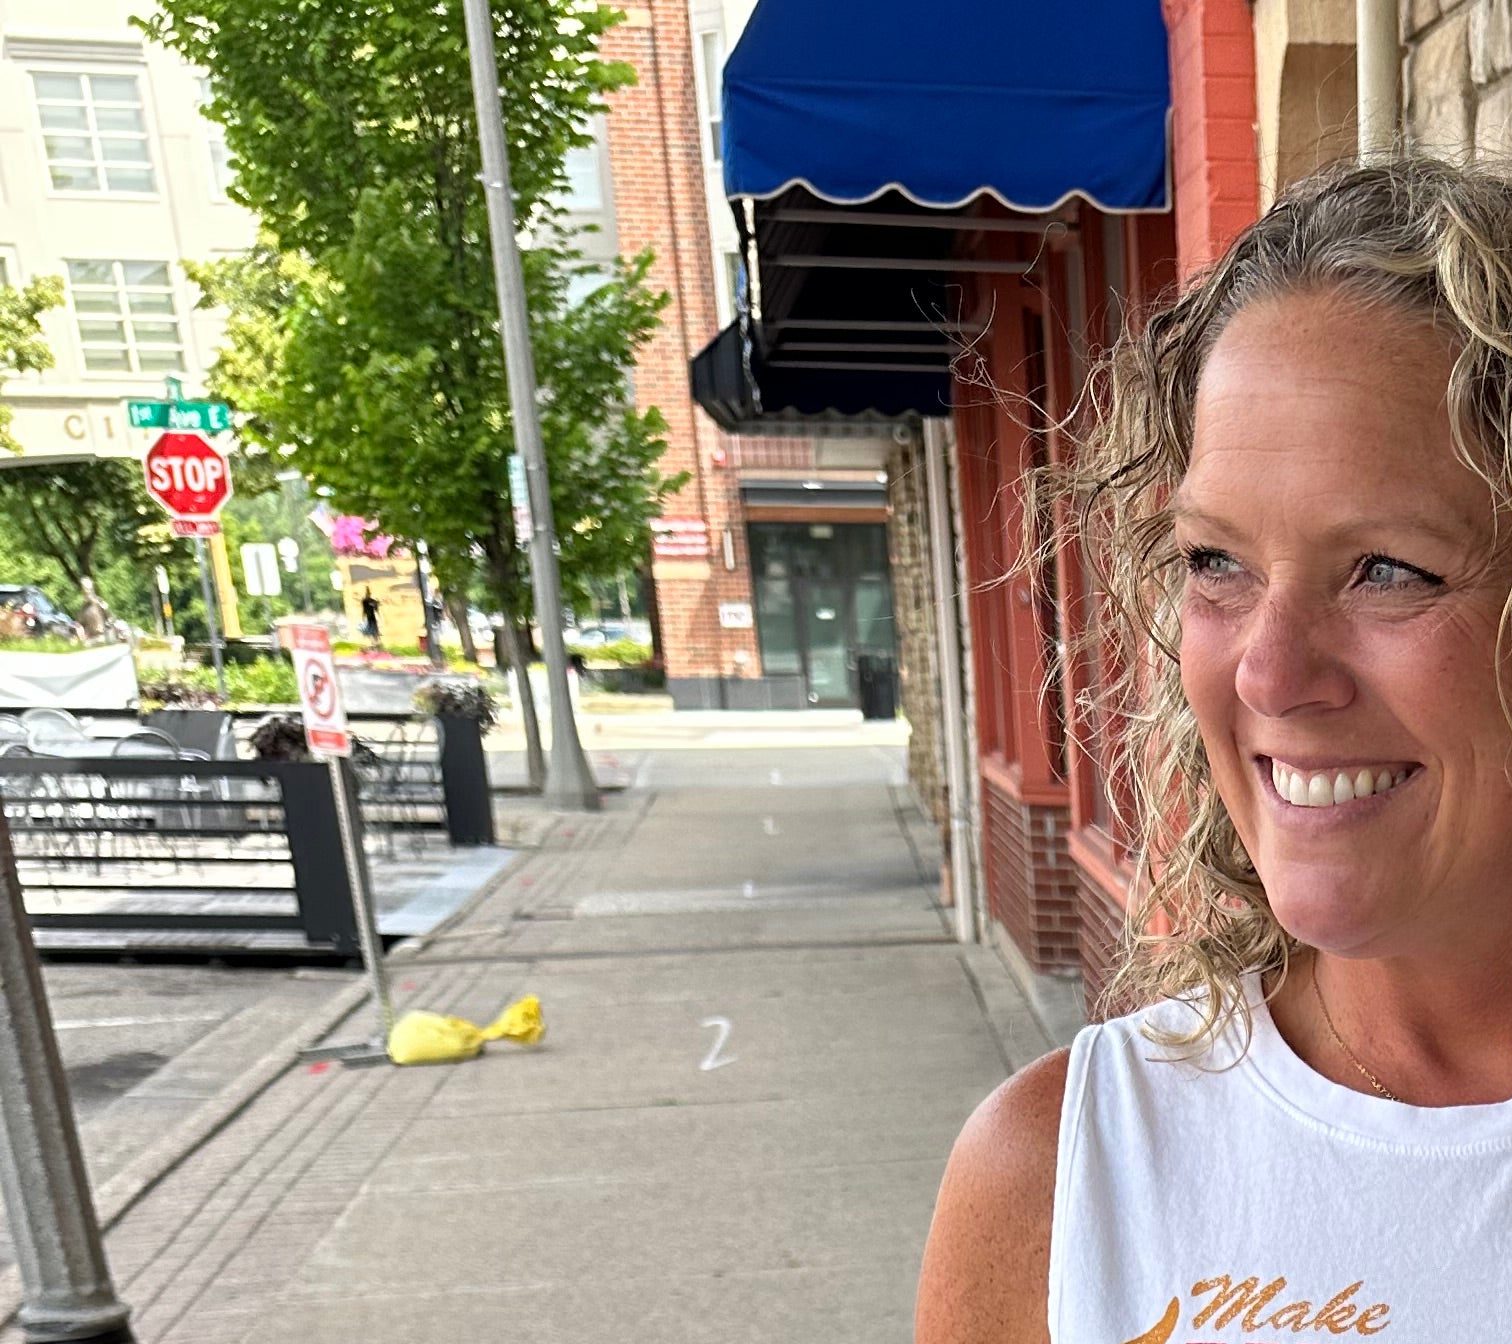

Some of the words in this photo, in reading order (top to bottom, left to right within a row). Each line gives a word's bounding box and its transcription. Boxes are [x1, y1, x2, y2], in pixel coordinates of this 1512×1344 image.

[150, 456, 223, 492] STOP
[700, 1016, 738, 1070] 2
[1190, 1273, 1392, 1336] Make
